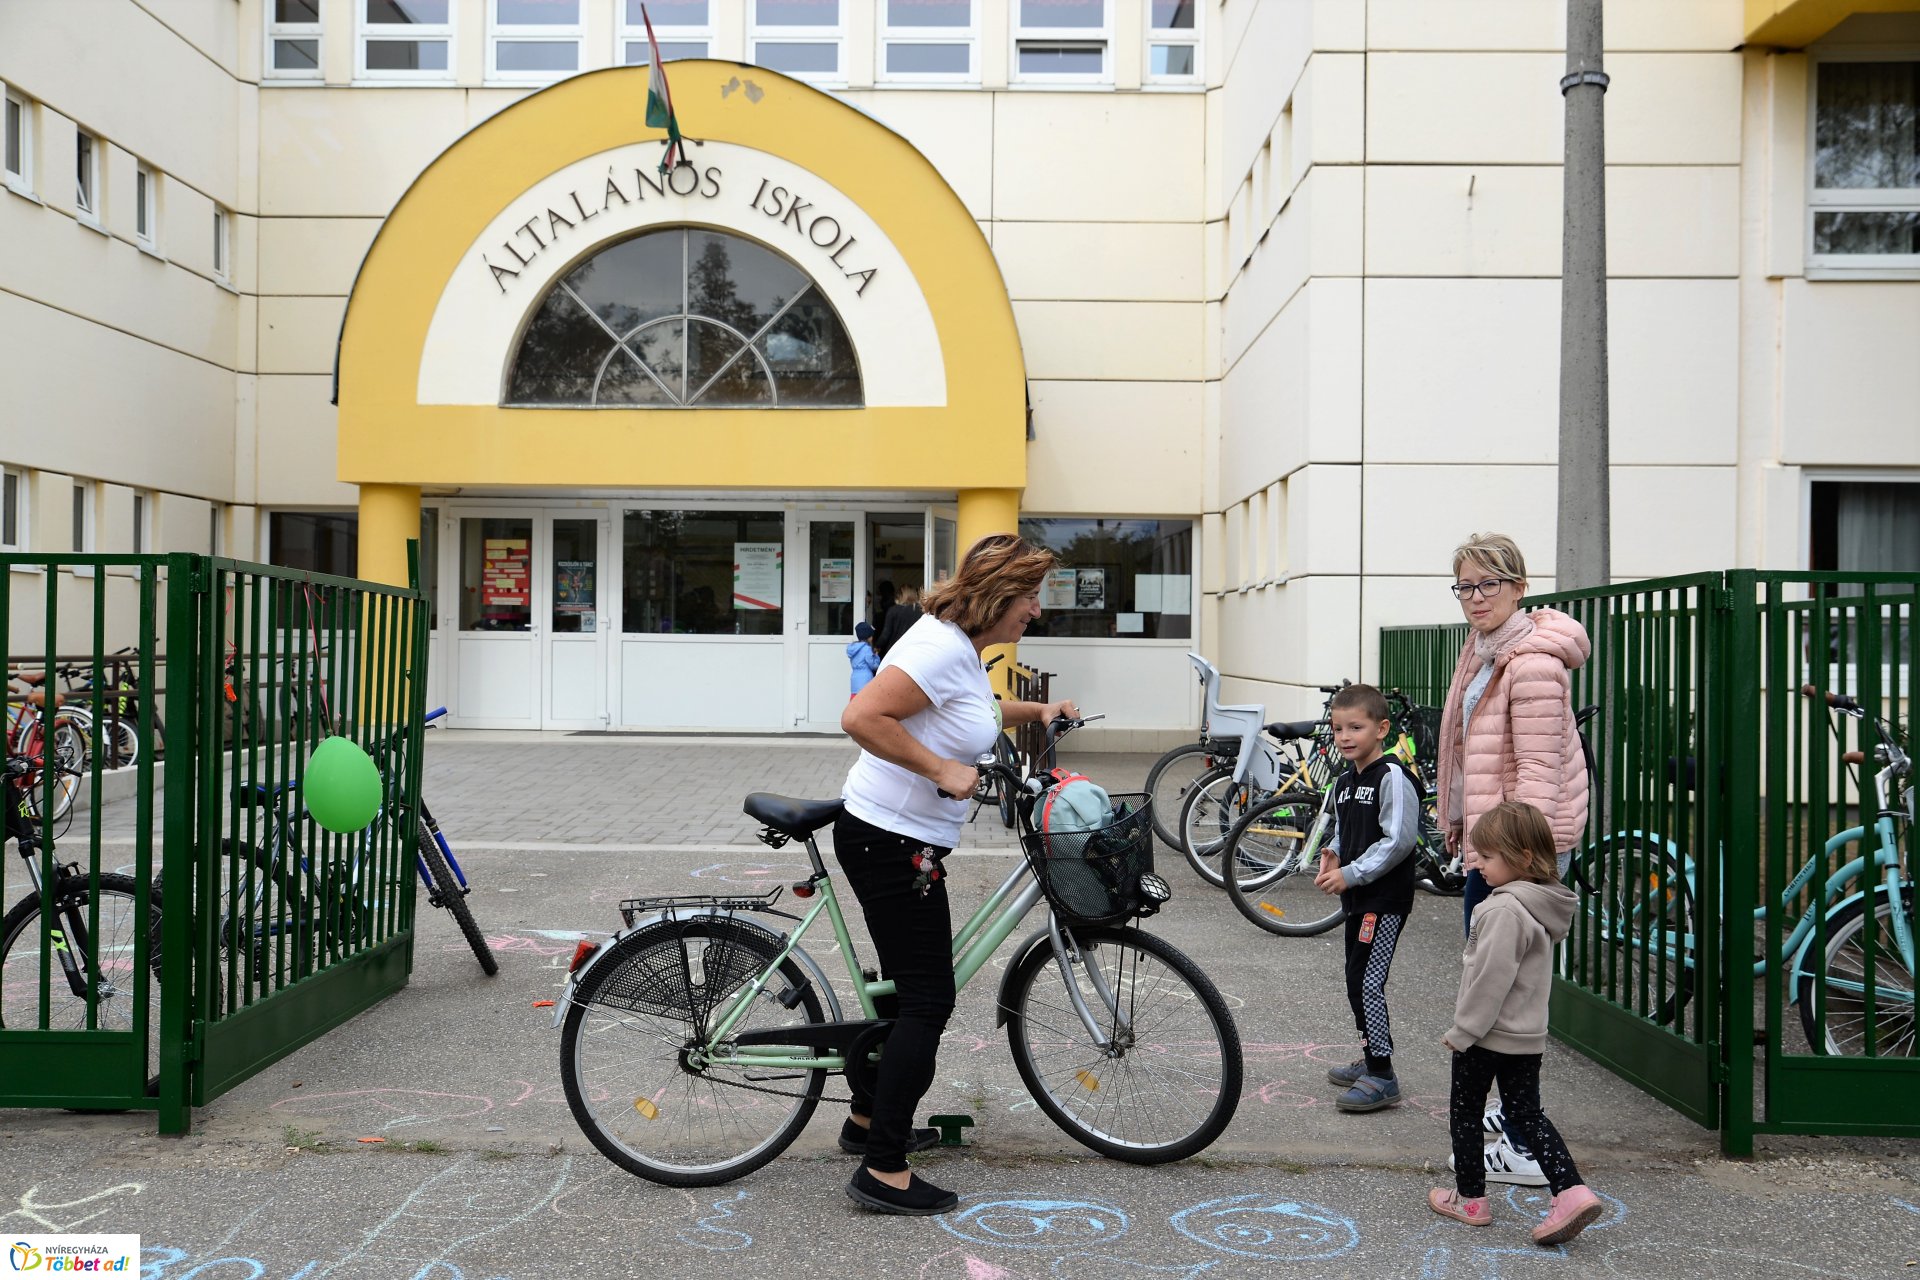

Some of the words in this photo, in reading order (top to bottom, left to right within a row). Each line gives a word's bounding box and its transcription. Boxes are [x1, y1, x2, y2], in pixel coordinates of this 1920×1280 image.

[482, 163, 722, 294] ÁLTALÁNOS
[750, 177, 879, 297] ISKOLA
[1355, 786, 1374, 800] DEPT.
